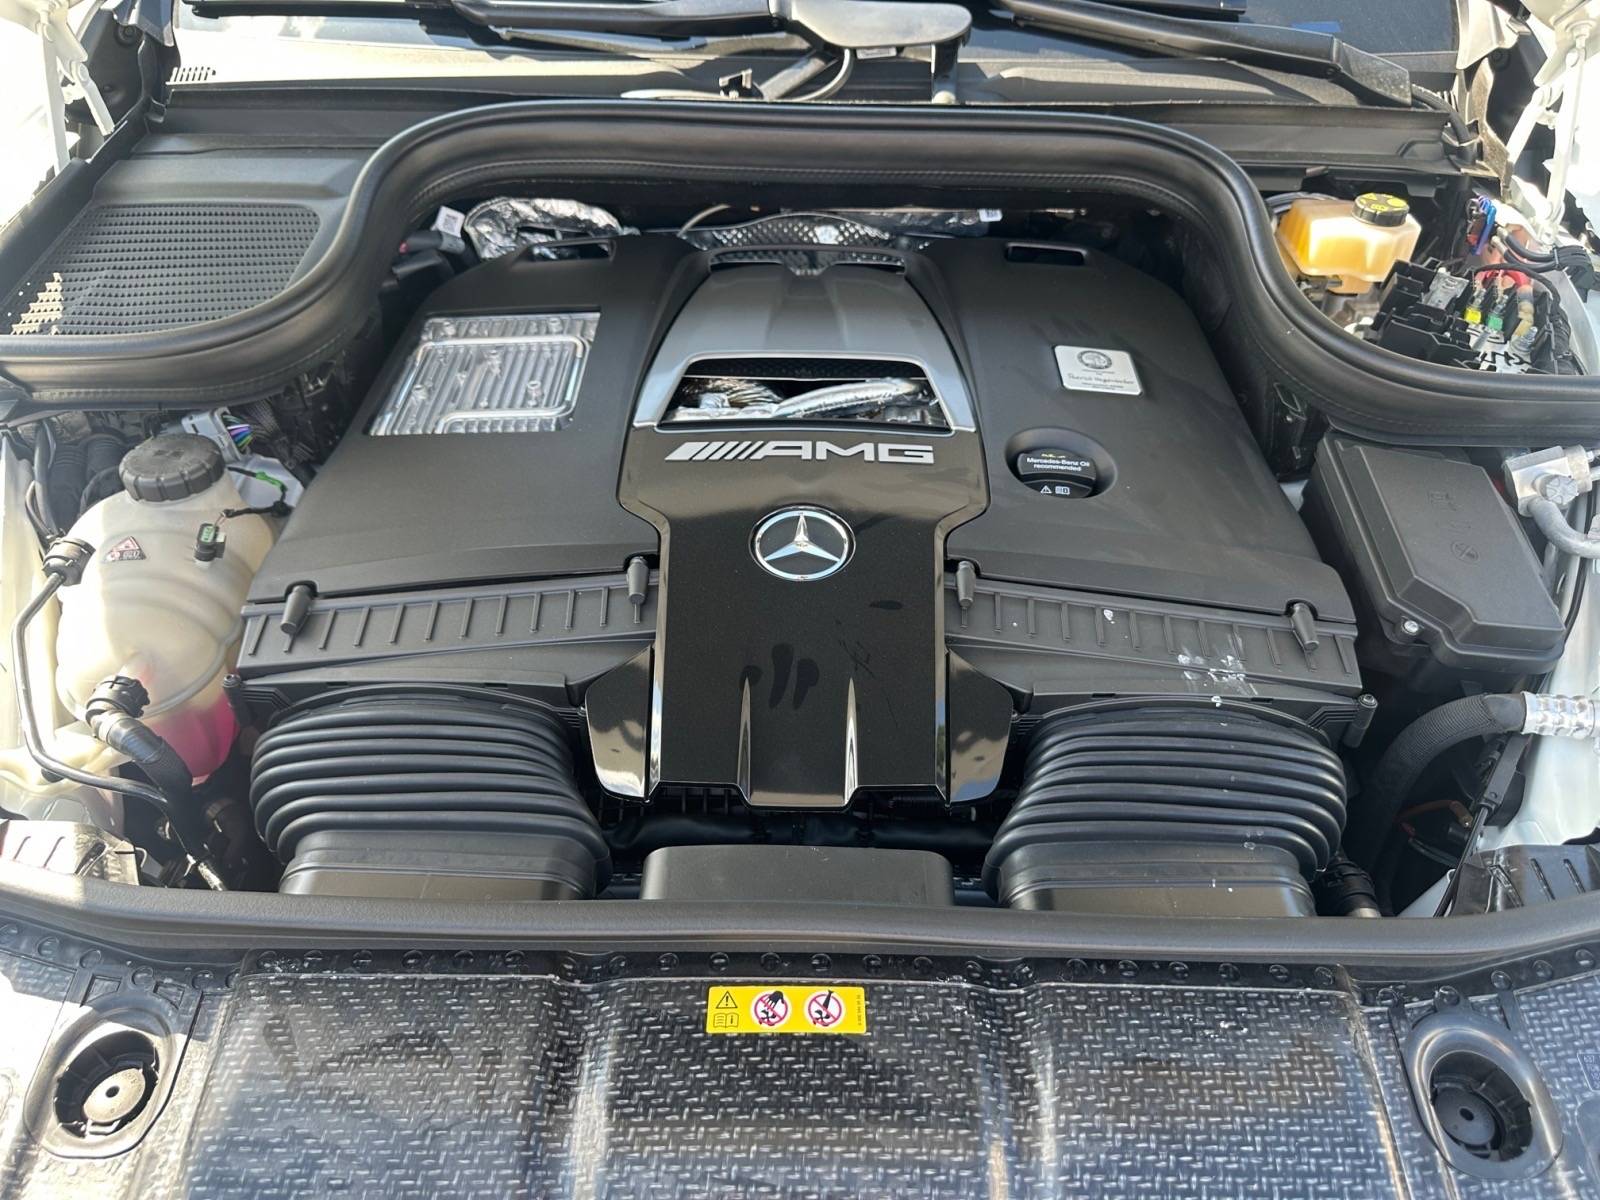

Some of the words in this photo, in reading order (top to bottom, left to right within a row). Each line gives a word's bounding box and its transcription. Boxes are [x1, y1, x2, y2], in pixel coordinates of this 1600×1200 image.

[750, 440, 934, 464] AMG
[1026, 457, 1079, 466] Mercedes-Benz
[1033, 463, 1082, 472] recommended
